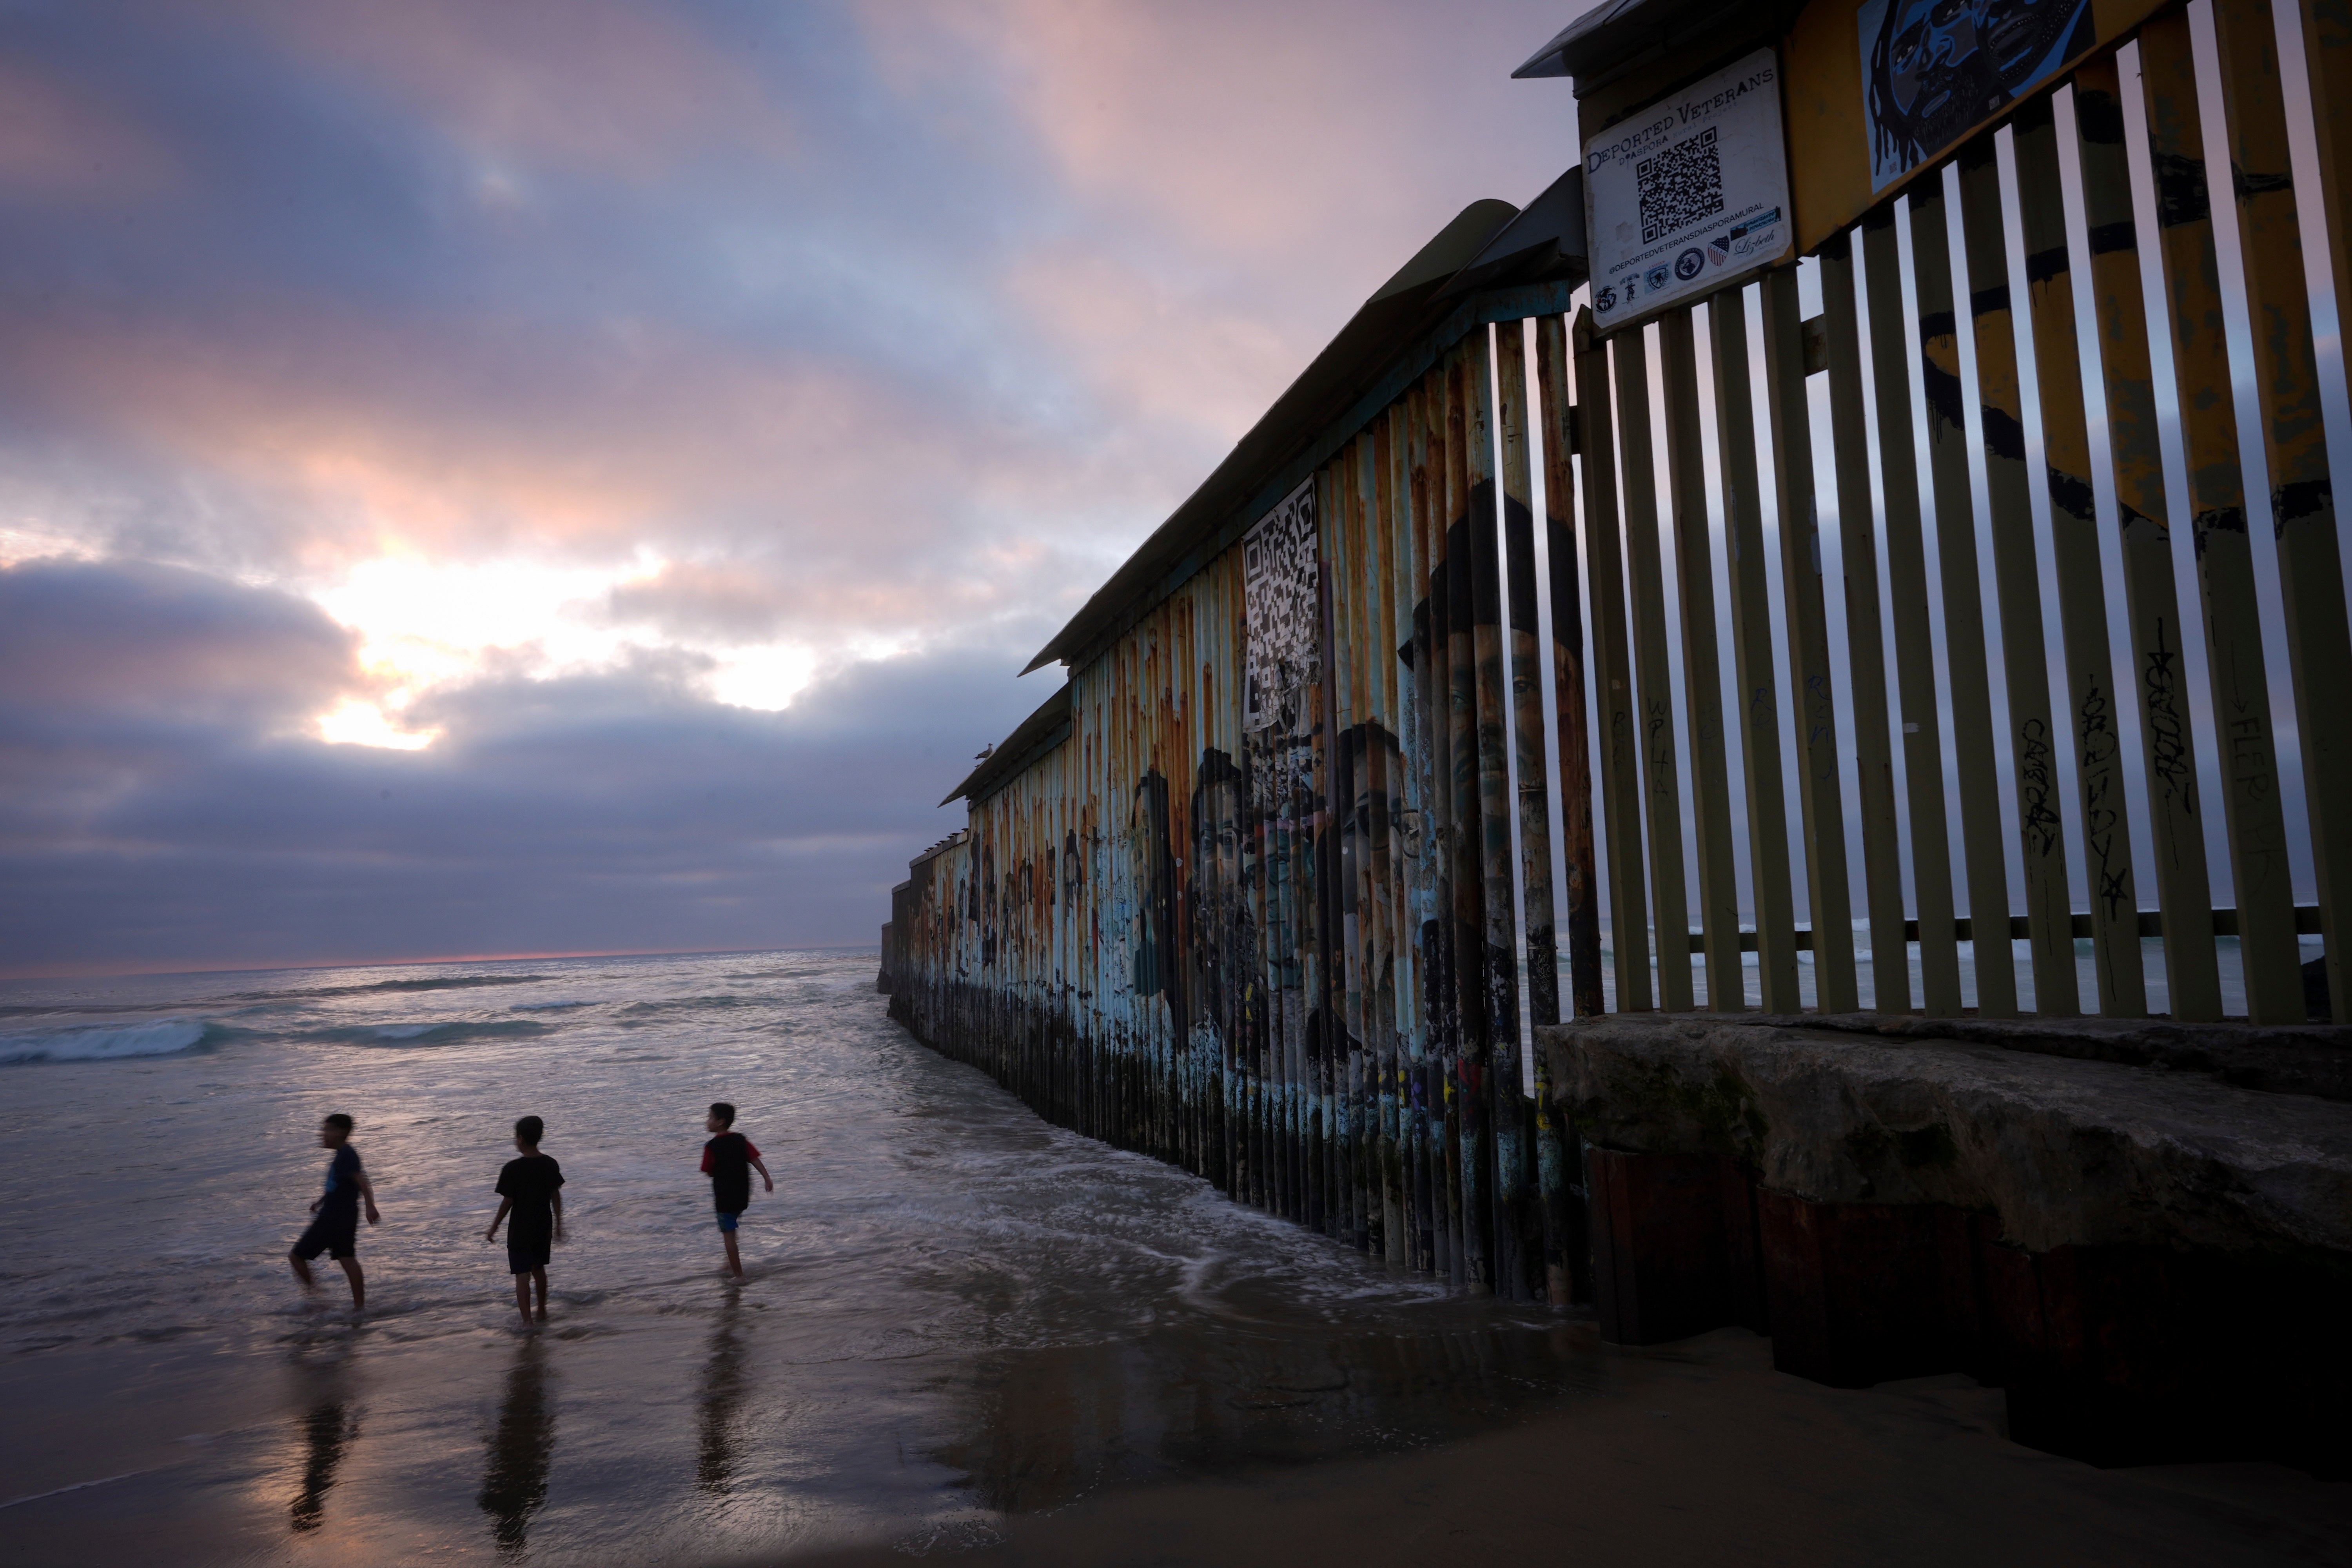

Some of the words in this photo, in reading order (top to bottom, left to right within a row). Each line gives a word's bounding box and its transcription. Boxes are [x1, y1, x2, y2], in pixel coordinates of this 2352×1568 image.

[1587, 116, 1673, 174] DEPORTED
[1677, 69, 1774, 124] VETERANS
[1703, 102, 1737, 122] Project
[1609, 203, 1764, 274] @DEPORTEDVETERANSDIASPORAMURAL
